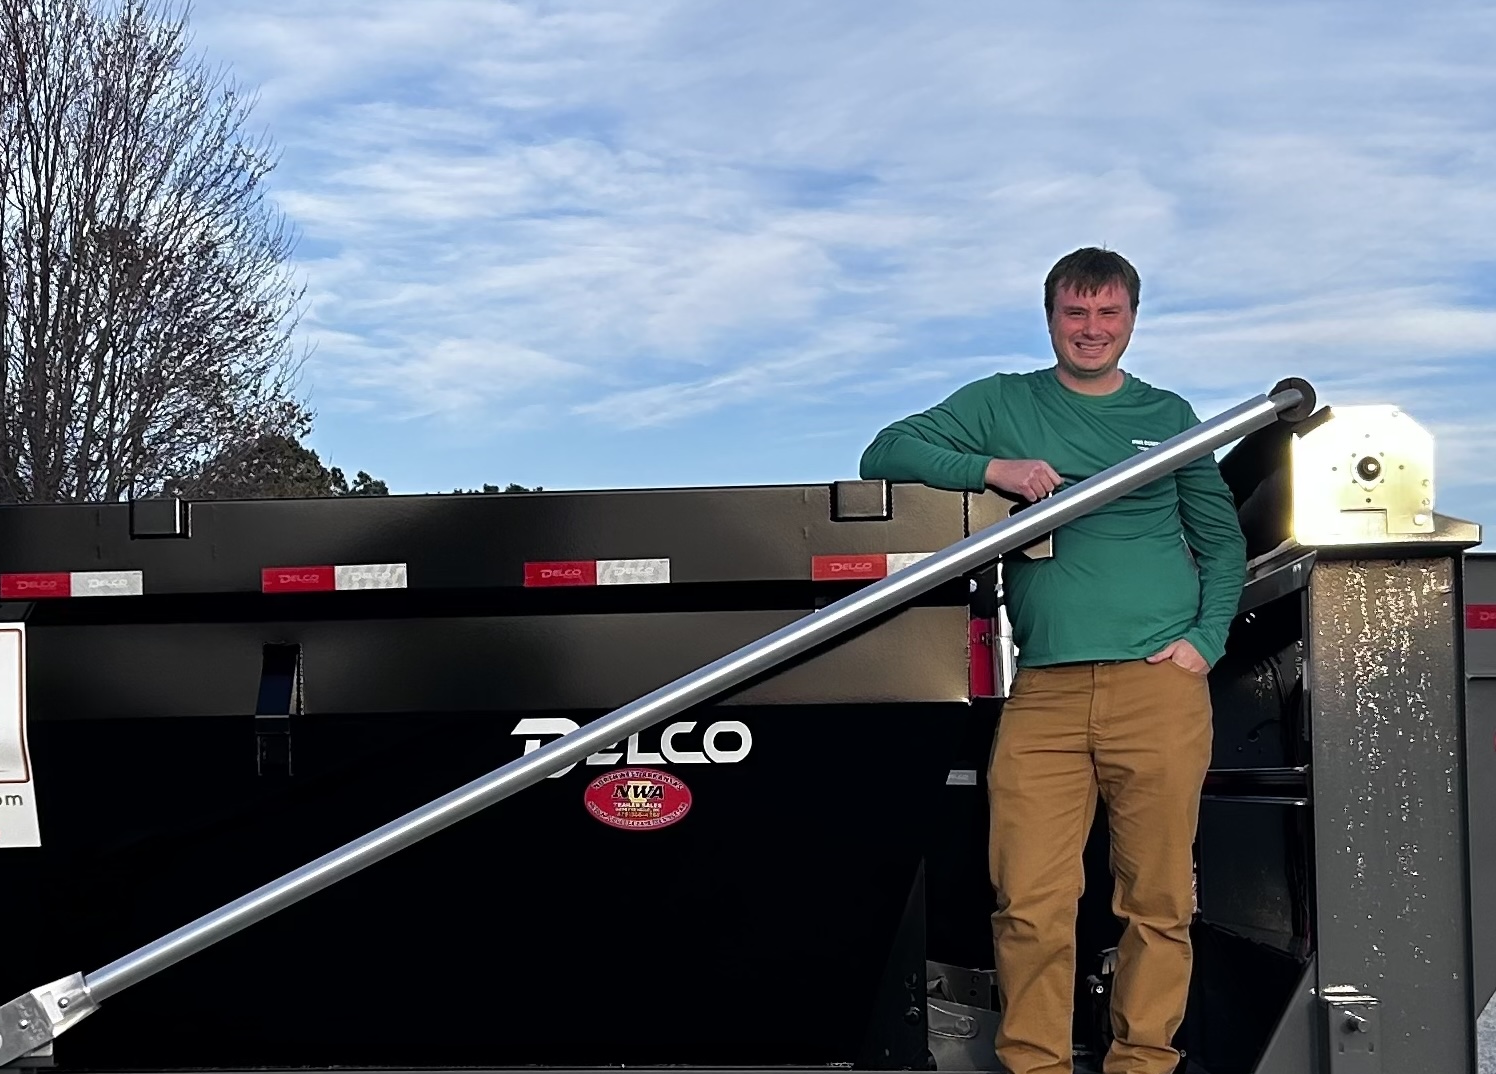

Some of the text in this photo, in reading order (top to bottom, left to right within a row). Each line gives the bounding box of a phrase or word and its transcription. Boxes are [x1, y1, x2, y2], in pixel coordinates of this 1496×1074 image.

[830, 562, 873, 572] DELCO
[540, 569, 582, 578] DELCO
[278, 574, 320, 584] DELCO
[16, 580, 57, 590] DELCO
[612, 784, 664, 799] NWA
